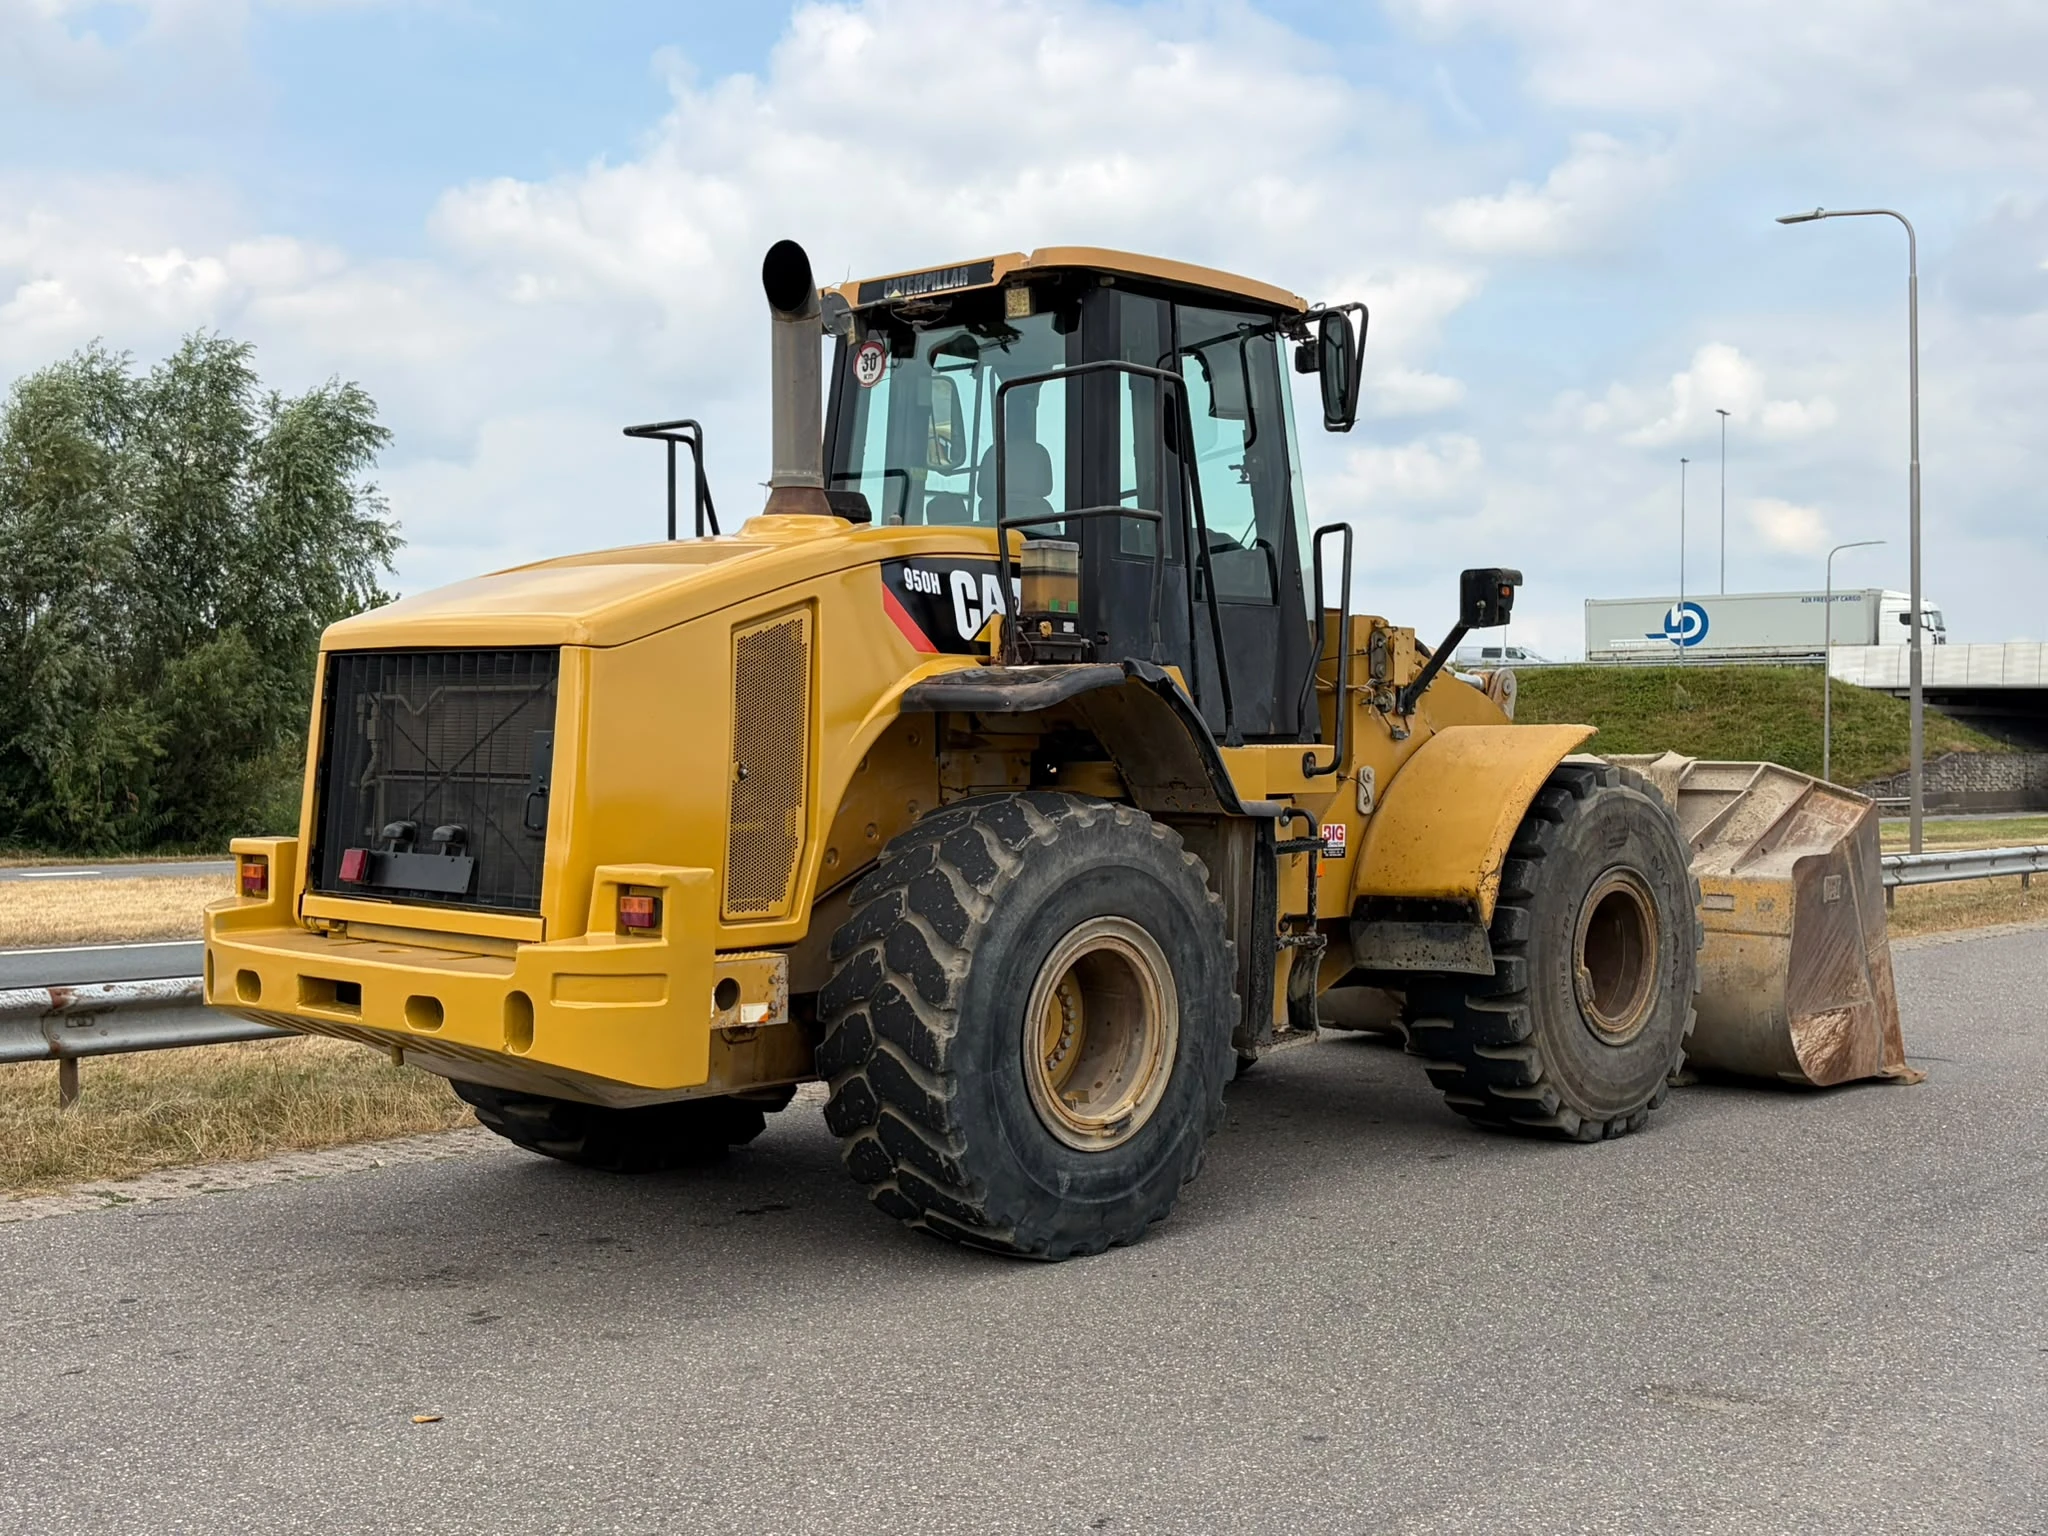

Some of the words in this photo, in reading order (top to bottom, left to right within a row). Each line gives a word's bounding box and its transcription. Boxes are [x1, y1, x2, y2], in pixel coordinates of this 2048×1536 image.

[884, 266, 969, 299] CATERPILLAR
[862, 352, 877, 372] 30
[904, 567, 941, 595] 950H
